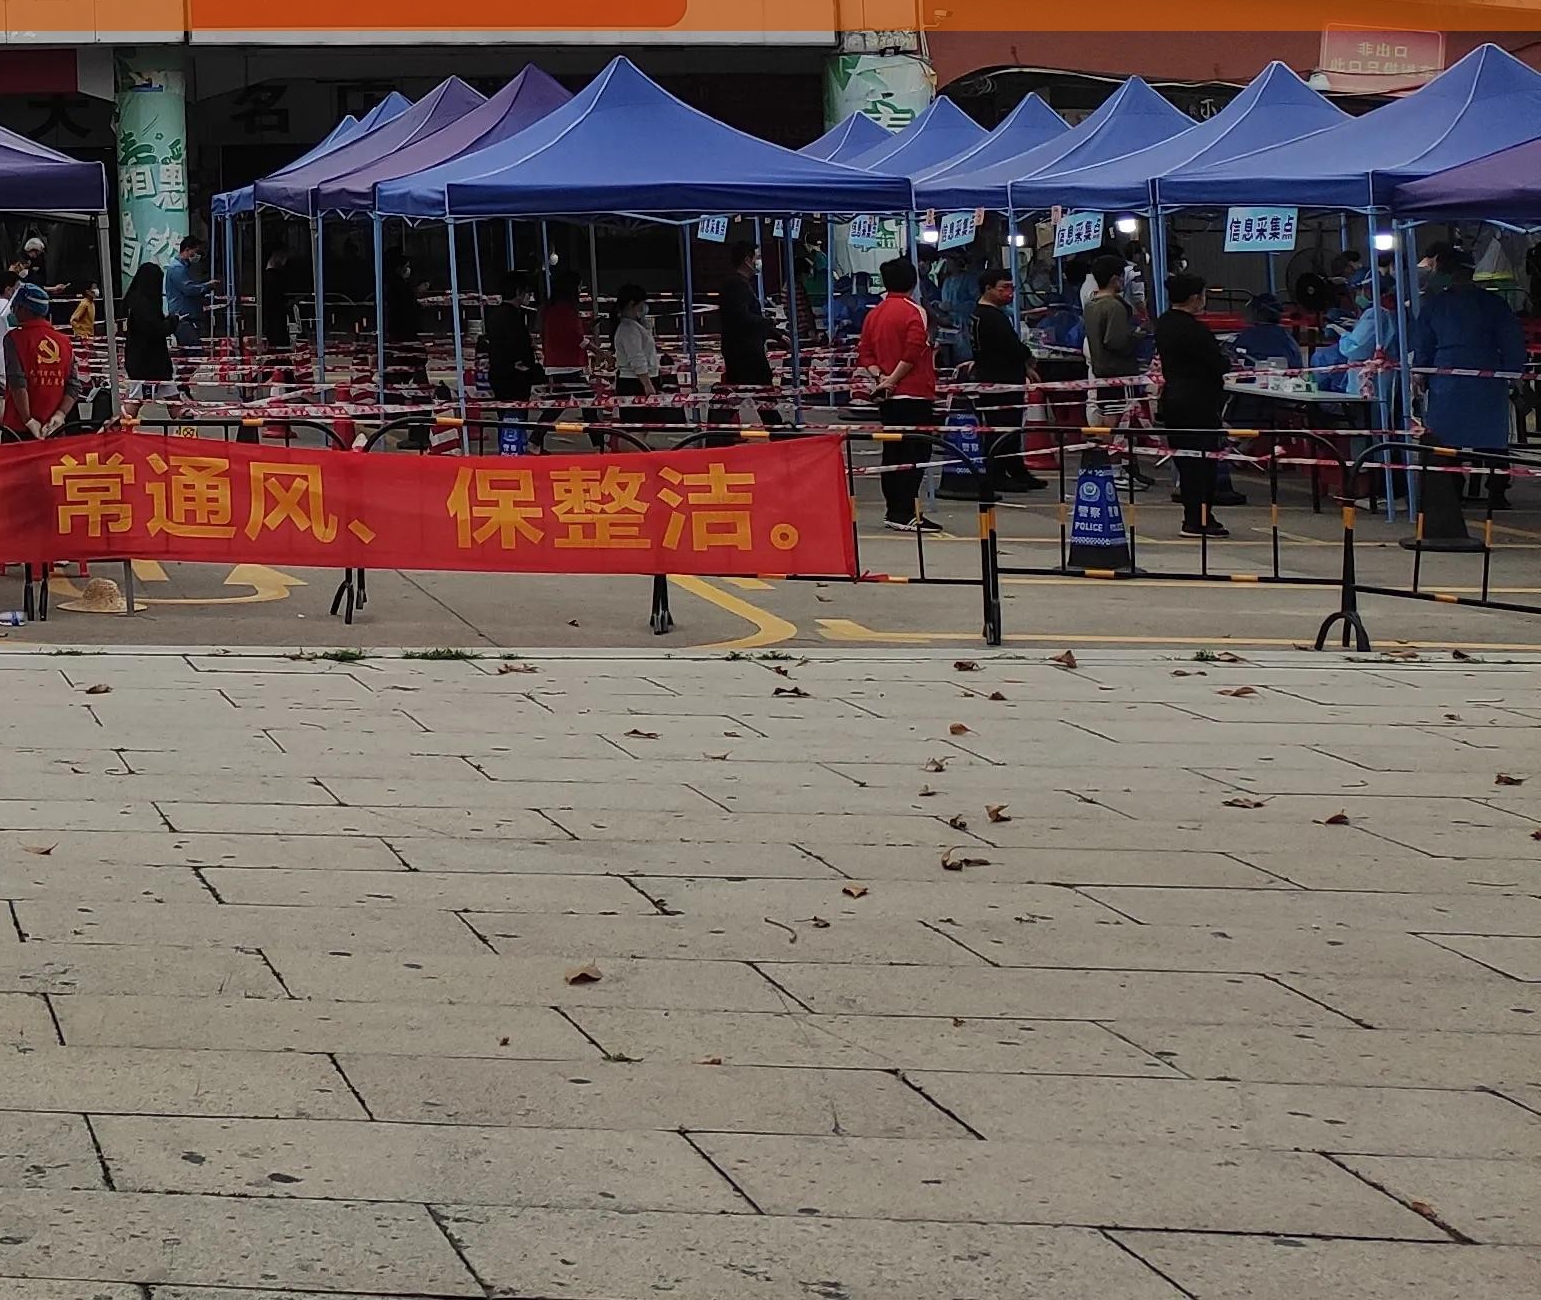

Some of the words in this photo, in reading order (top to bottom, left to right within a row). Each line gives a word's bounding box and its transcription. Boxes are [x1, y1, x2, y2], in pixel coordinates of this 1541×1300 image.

[1230, 214, 1294, 242] 信息采集点
[50, 451, 378, 546] 常通风、
[445, 461, 800, 553] 保整洁。
[1074, 521, 1104, 532] POLICE
